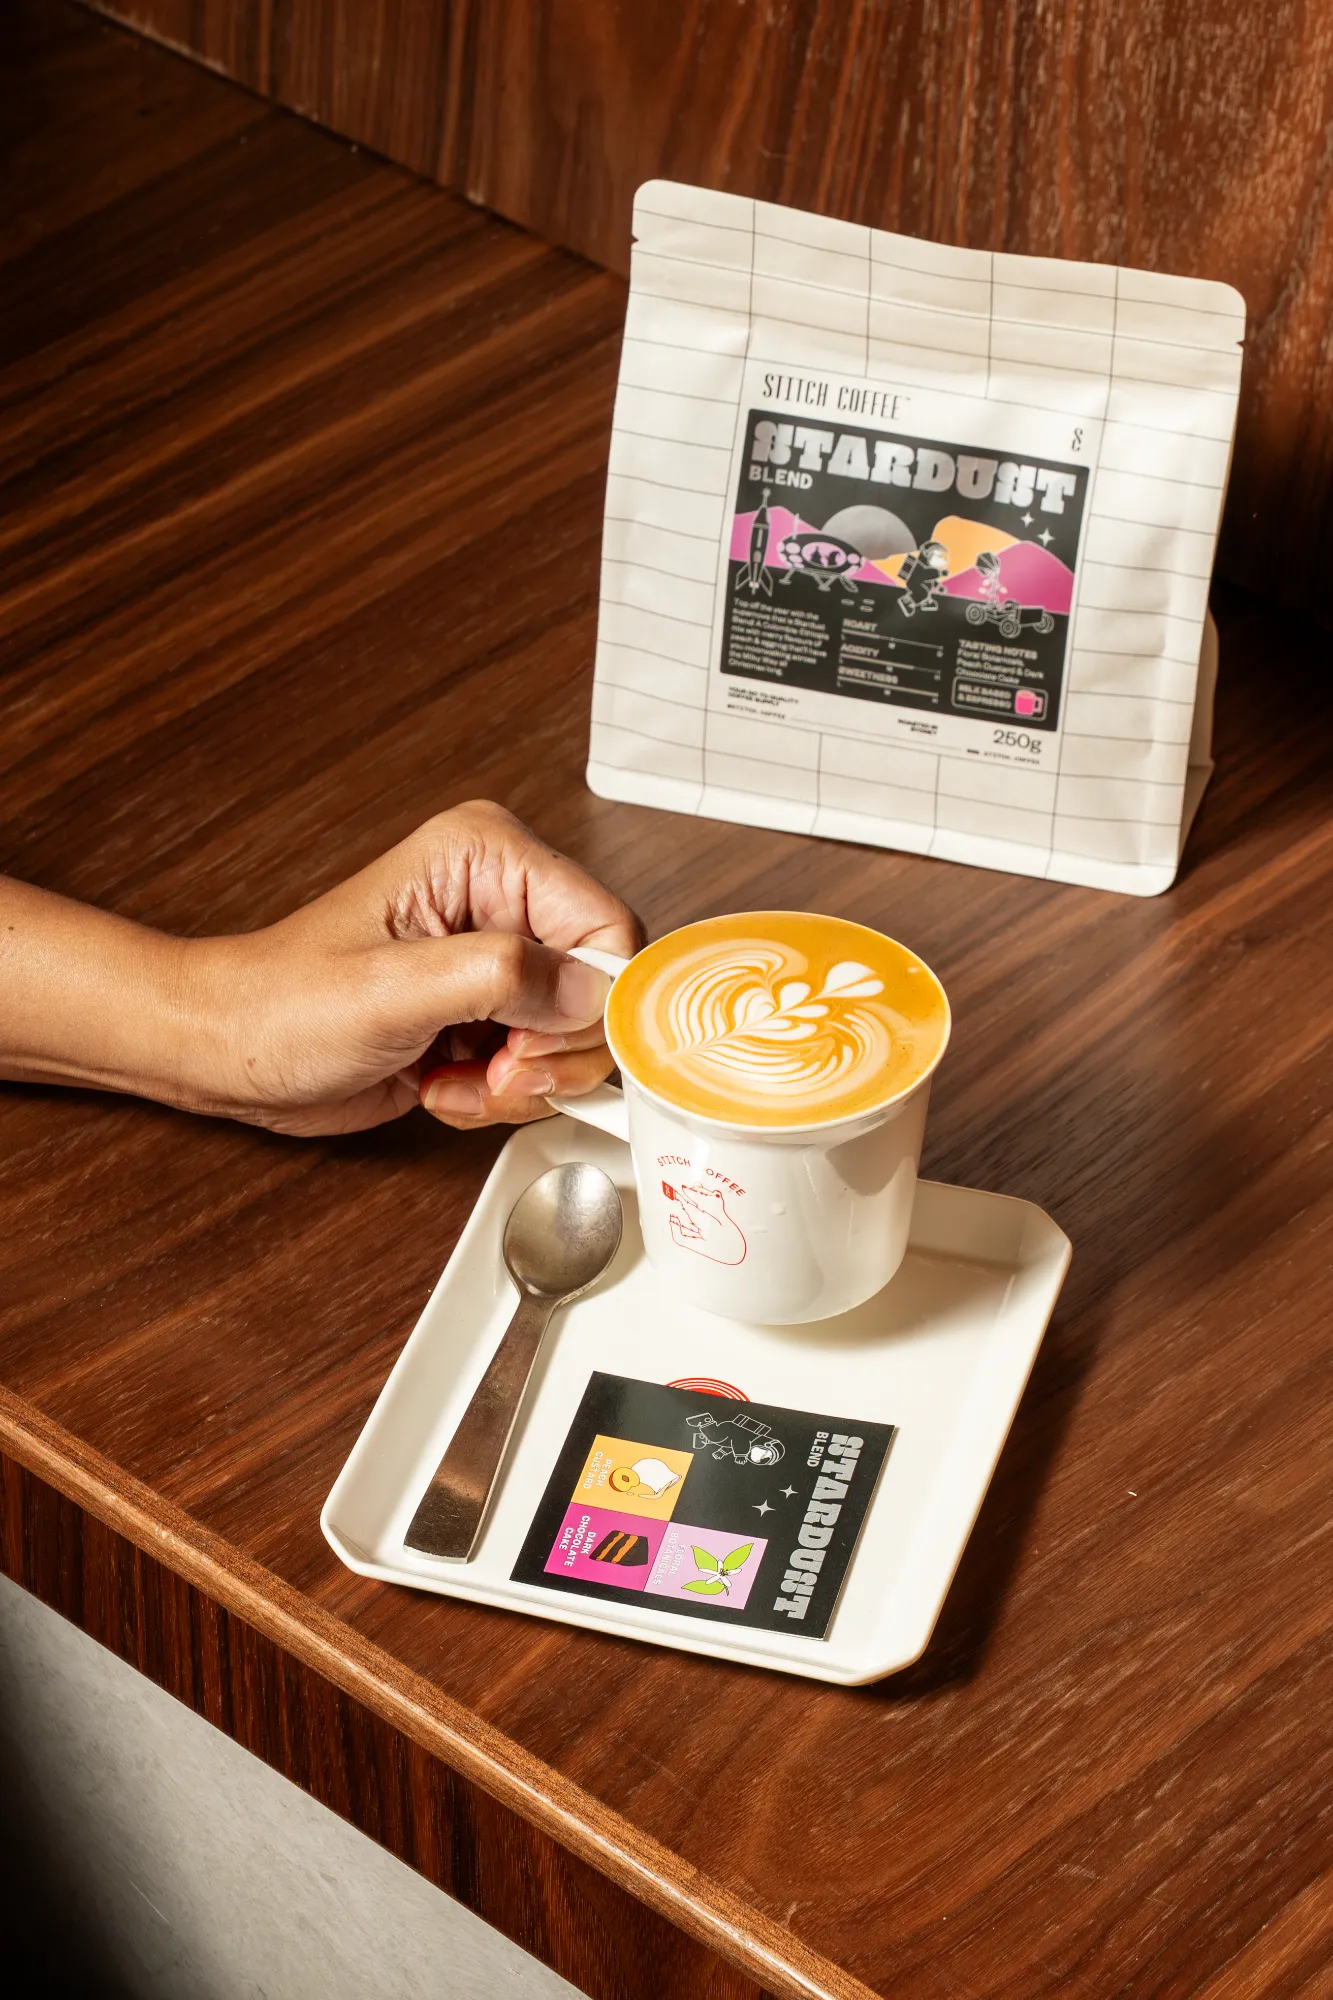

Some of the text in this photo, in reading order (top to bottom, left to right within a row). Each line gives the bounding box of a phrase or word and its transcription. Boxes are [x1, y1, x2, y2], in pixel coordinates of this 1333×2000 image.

[763, 373, 828, 407] STITCH
[748, 464, 813, 489] BLEND
[751, 420, 1077, 515] STARDUST
[843, 618, 878, 632] ROAST
[840, 643, 880, 657] ACIDITY
[958, 639, 1003, 655] TASTING
[1003, 646, 1038, 660] NOTES
[838, 666, 898, 685] SWEETNESS
[1023, 669, 1044, 679] Dark
[993, 728, 1042, 755] 250g
[657, 1155, 746, 1197] STITCH OFFEE
[806, 1430, 829, 1468] BLEND
[583, 1451, 603, 1490] CUSTARD
[596, 1458, 612, 1487] PEACH
[559, 1527, 574, 1551] CAKE
[564, 1515, 590, 1567] CHOCOLATE
[773, 1433, 864, 1620] STARDUST
[581, 1531, 596, 1555] DARK
[653, 1531, 679, 1586] BOTANICALS
[668, 1543, 687, 1576] FLORAL
